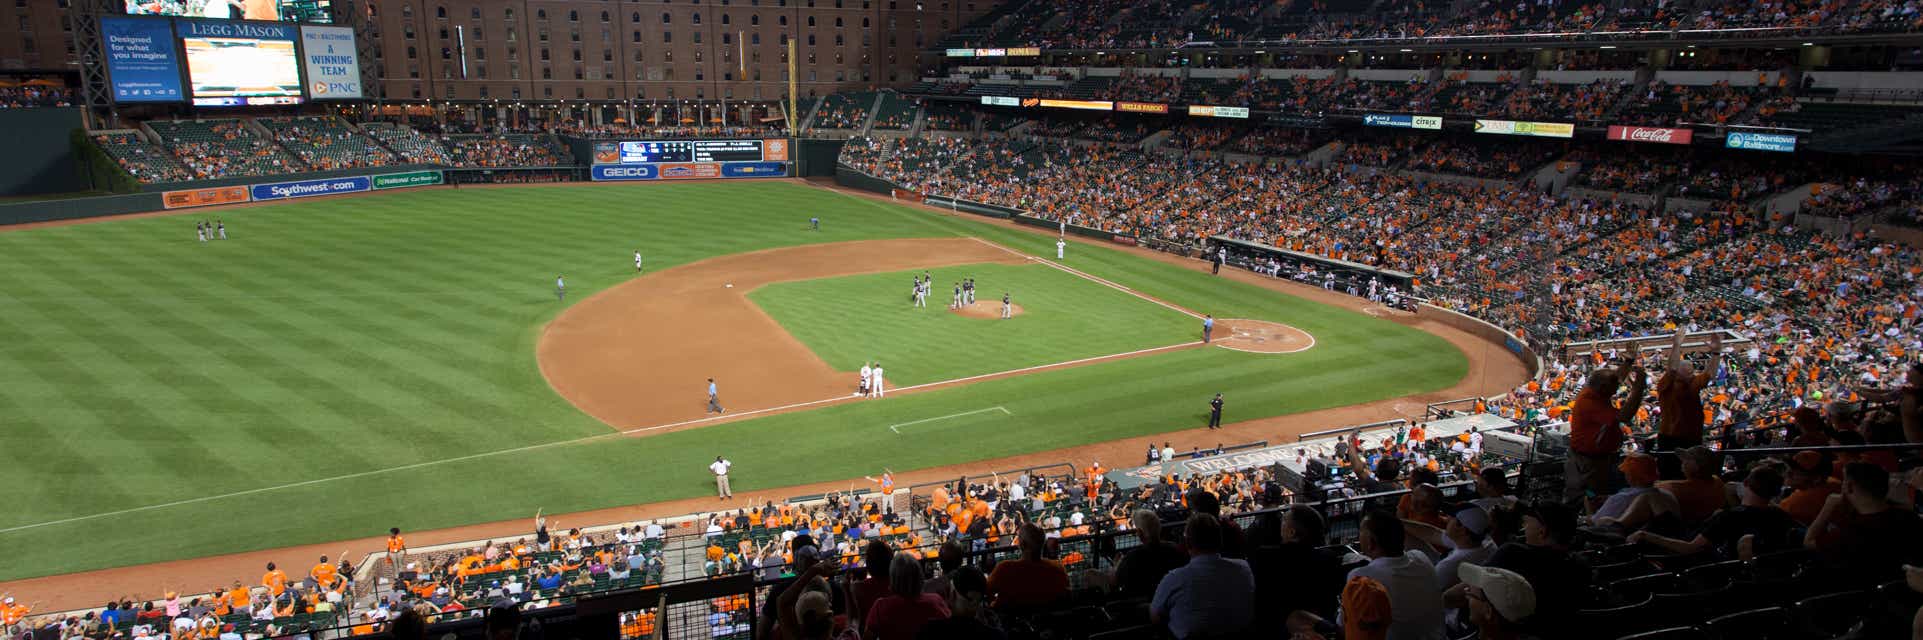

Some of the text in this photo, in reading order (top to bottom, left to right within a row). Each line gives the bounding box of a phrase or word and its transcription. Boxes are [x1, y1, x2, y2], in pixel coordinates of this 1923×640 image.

[191, 22, 284, 37] LEGG MASON
[110, 35, 152, 44] Designed
[328, 44, 335, 54] A
[132, 52, 168, 60] imagine
[311, 55, 353, 65] WINNING
[320, 66, 347, 76] TEAM
[329, 82, 357, 93] PNC
[1121, 103, 1142, 111] WELLS
[1142, 104, 1164, 112] FARGO
[603, 167, 648, 178] GEICO
